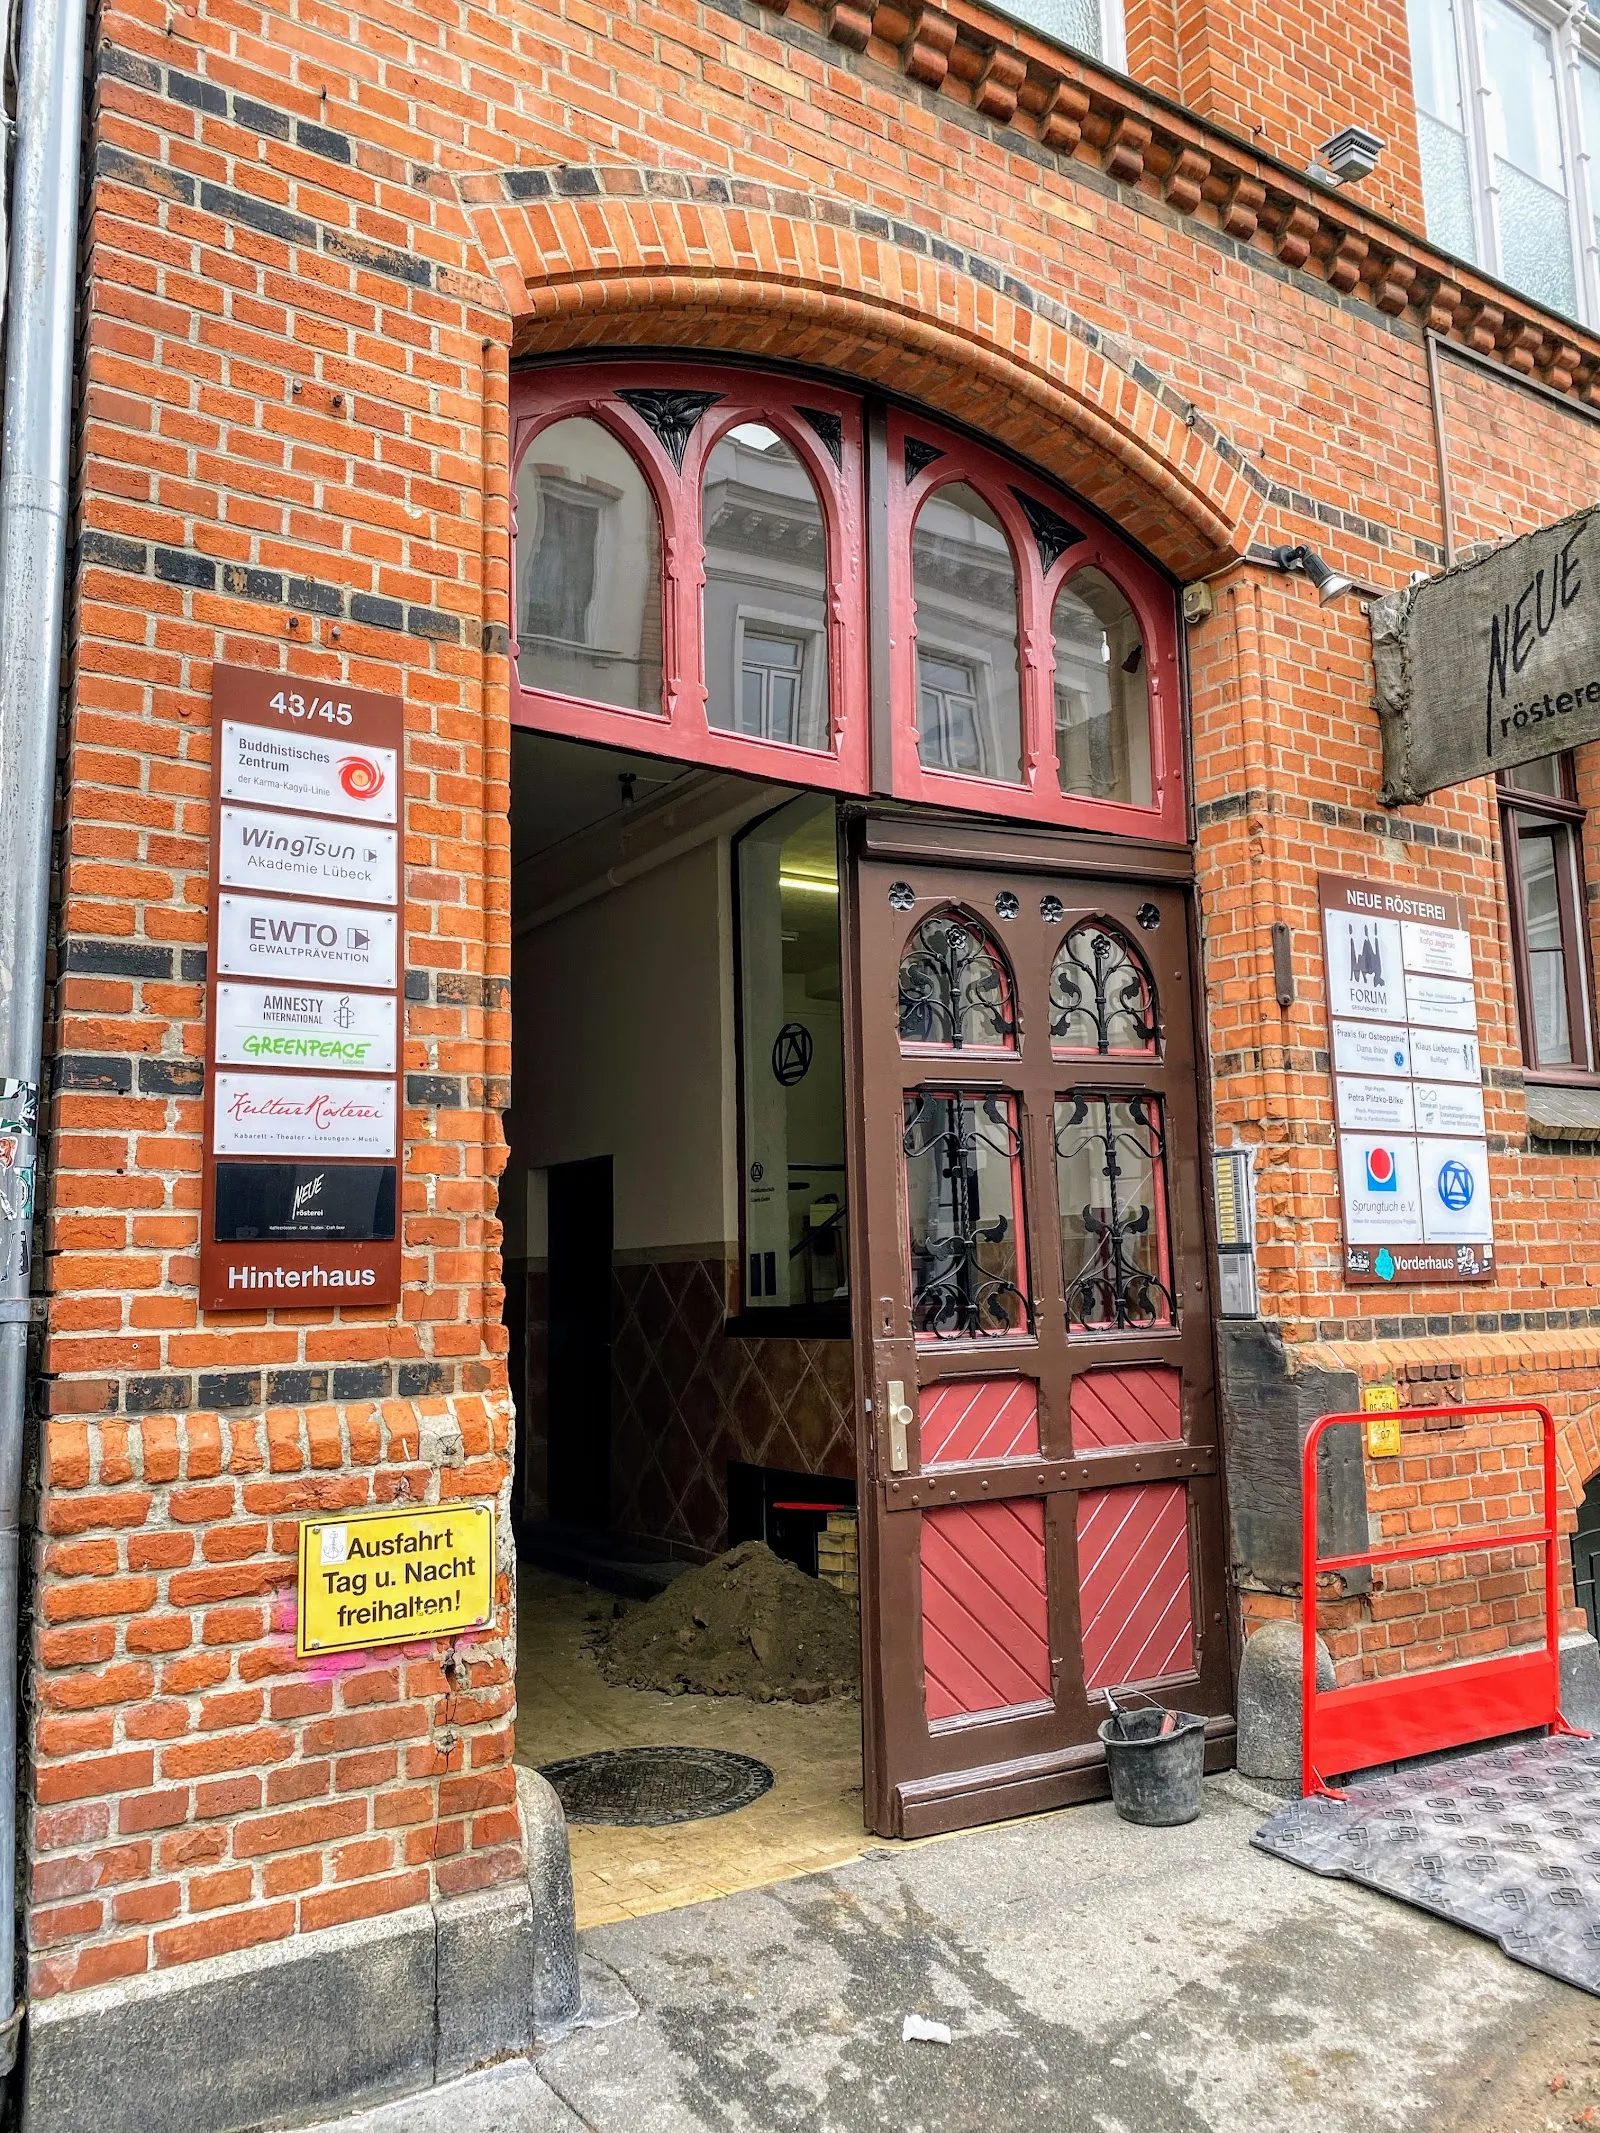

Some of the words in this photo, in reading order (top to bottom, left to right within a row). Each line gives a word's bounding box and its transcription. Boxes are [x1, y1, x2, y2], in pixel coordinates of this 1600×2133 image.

[1487, 521, 1588, 757] NEUE
[269, 690, 353, 726] 43/45
[238, 737, 330, 764] Buddhistisches
[238, 753, 289, 773] Zentrum
[237, 773, 251, 785] der
[253, 776, 330, 797] Karma-Kagyü-Linie
[241, 826, 356, 860] WingTsun
[247, 855, 318, 875] Akademie
[323, 864, 372, 882] Lübeck
[1346, 890, 1383, 908] NEUE
[1385, 894, 1446, 921] RÖSTEREI
[249, 917, 338, 947] EWTO
[249, 943, 369, 963] GEWALTPRÄVENTION
[263, 994, 323, 1013] AMNESTY
[1350, 988, 1387, 1006] FORUM
[263, 1011, 323, 1025] INTERNATIONAL
[242, 1034, 371, 1059] GREENPEACE
[1337, 1028, 1357, 1039] Praxis
[1358, 1030, 1367, 1040] für
[1368, 1031, 1405, 1044] Osteopathie
[1356, 1044, 1372, 1055] Dana
[1415, 1042, 1431, 1053] Klaus
[1432, 1043, 1460, 1055] Liebetrau
[1348, 1093, 1365, 1103] Petra
[234, 1132, 267, 1141] Kabarett
[276, 1132, 305, 1141] Theater
[314, 1134, 350, 1143] Lesungen
[358, 1135, 379, 1143] Musik
[292, 1172, 325, 1220] NEUE
[1352, 1199, 1399, 1215] Sprungtuch
[1400, 1201, 1416, 1213] e.V.
[296, 1208, 324, 1217] rösterei
[1393, 1255, 1454, 1271] Vorderhaus
[228, 1265, 376, 1289] Hinterhaus
[346, 1528, 454, 1561] Ausfahrt
[322, 1571, 367, 1597] Tag
[375, 1570, 396, 1588] u.
[405, 1556, 476, 1584] Nacht
[337, 1590, 461, 1627] freihalten!
